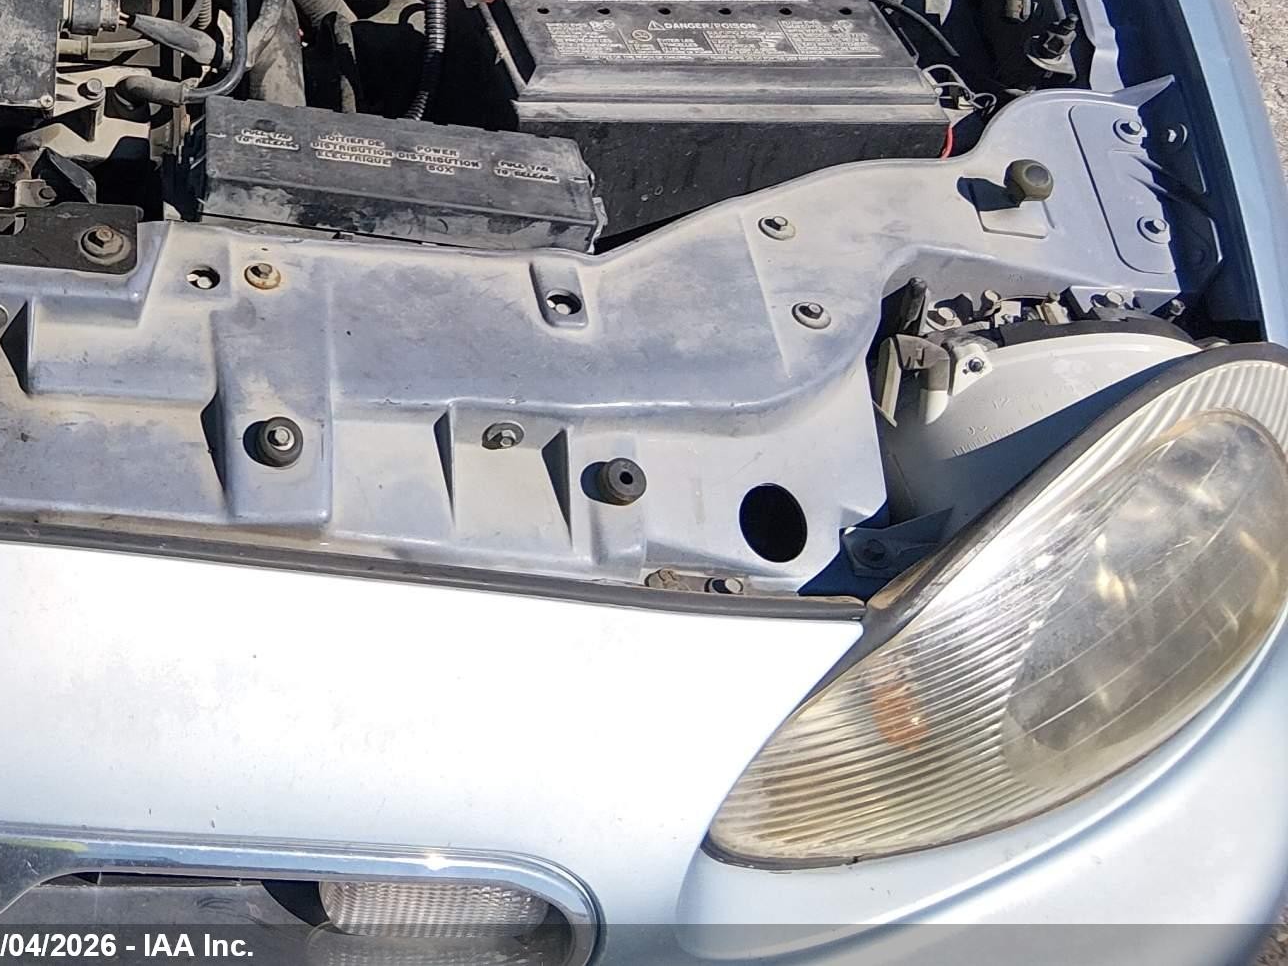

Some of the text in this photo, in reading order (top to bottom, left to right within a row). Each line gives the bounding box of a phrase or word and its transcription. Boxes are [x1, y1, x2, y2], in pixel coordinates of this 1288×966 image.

[312, 141, 393, 157] DISTRIBUTION
[367, 139, 385, 148] DE
[416, 145, 458, 157] POWER
[398, 152, 481, 168] DISTRIBUTION
[428, 165, 454, 174] BOX
